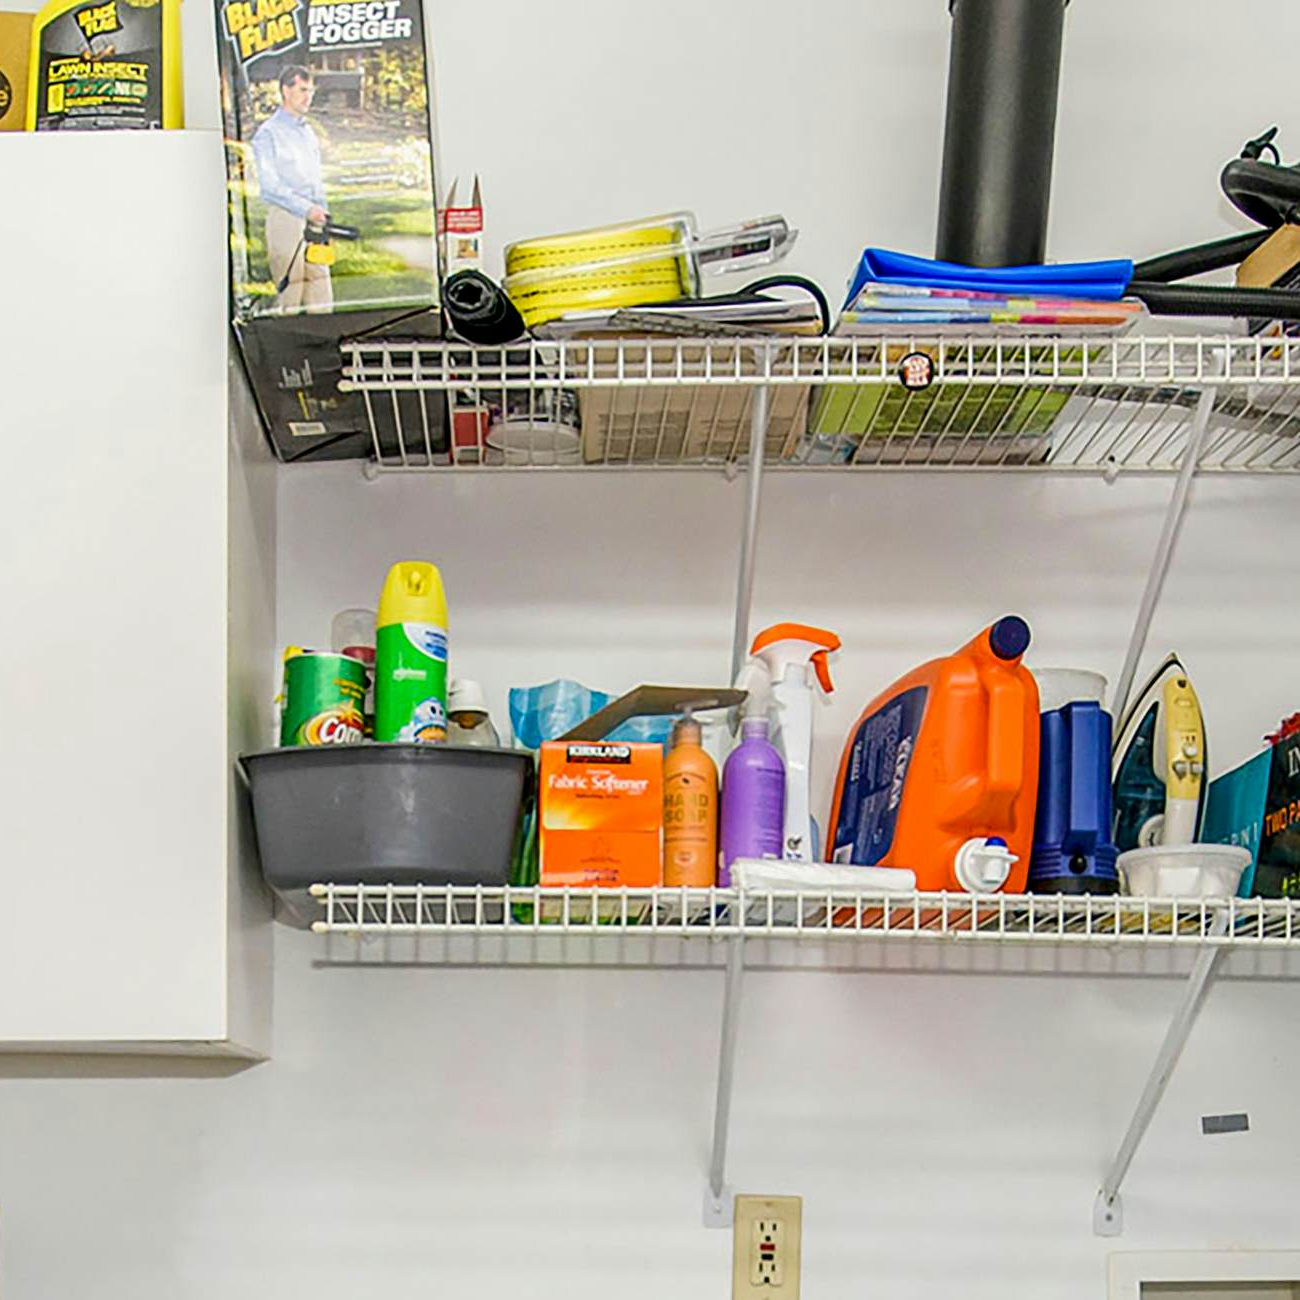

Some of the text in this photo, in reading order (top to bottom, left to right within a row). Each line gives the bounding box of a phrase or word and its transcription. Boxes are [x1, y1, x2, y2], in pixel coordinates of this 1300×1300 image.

[78, 2, 116, 26] BLACK
[226, 0, 299, 33] BLACK
[308, 2, 400, 25] INSECT
[85, 17, 118, 36] FLAG
[239, 15, 295, 58] FLAG
[309, 18, 412, 43] FOGGER
[49, 63, 148, 77] LAWN INSECT
[549, 773, 649, 794] Fabric Softener
[1266, 807, 1287, 837] TWO
